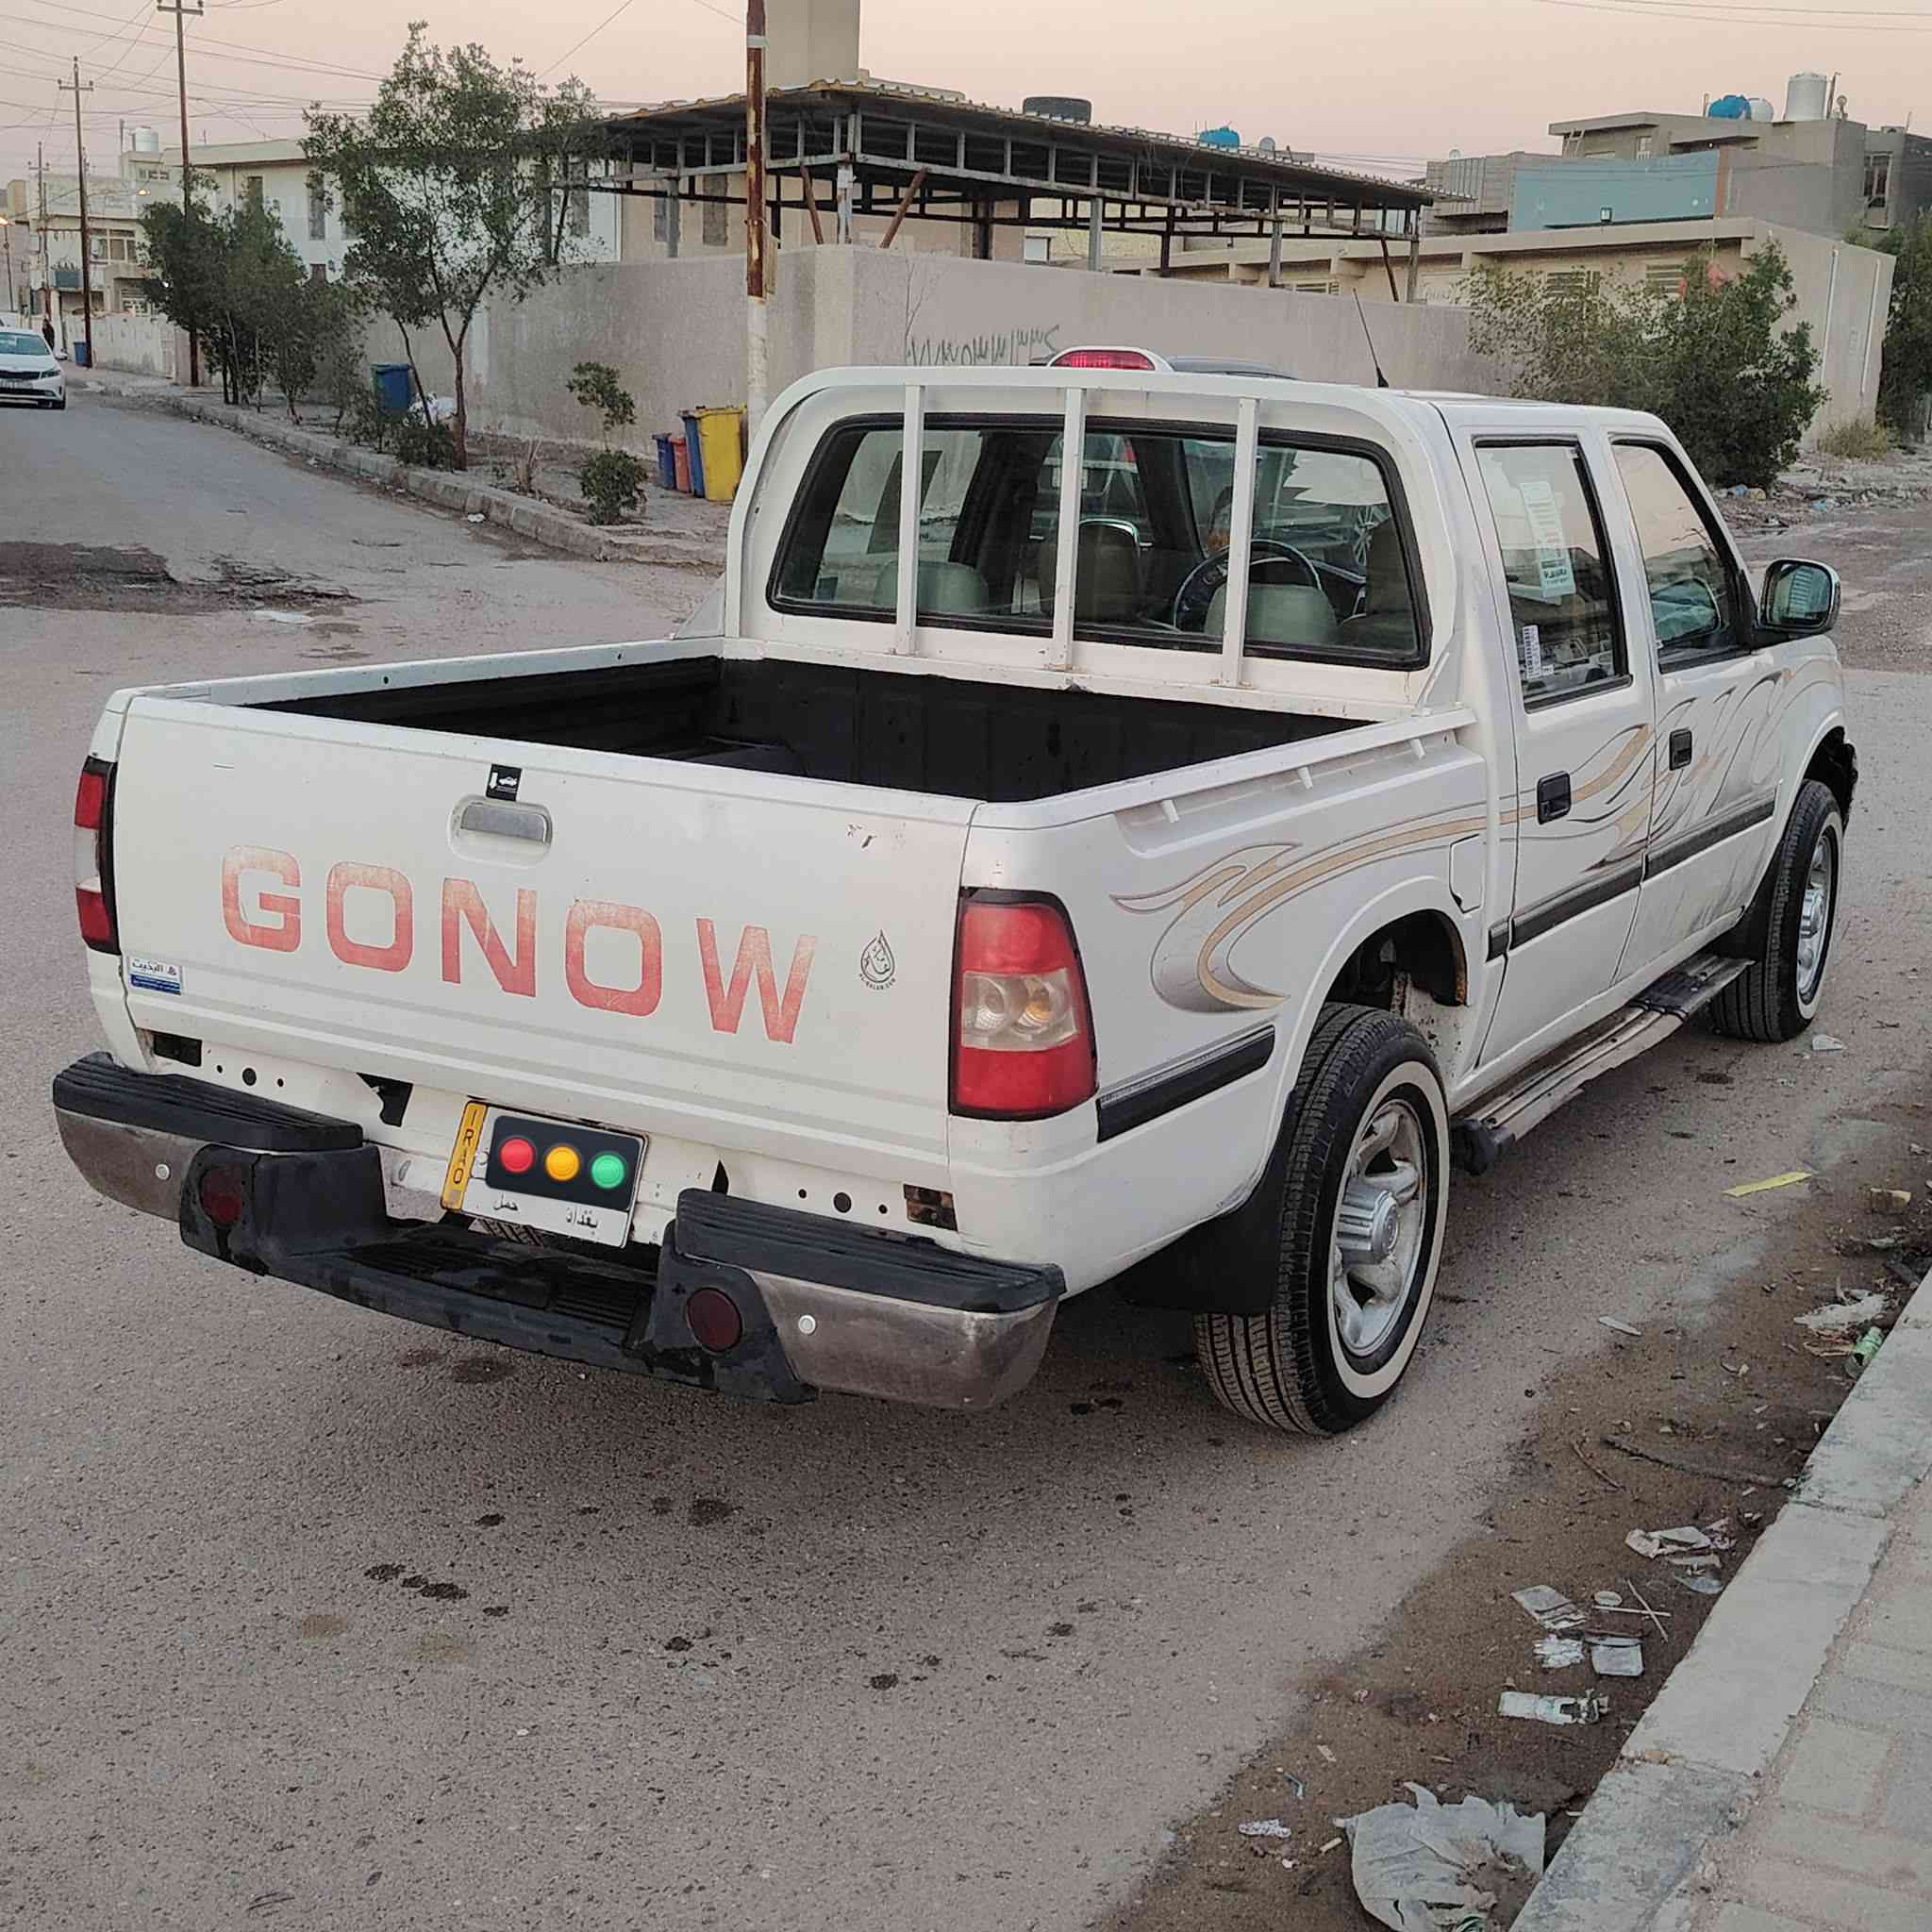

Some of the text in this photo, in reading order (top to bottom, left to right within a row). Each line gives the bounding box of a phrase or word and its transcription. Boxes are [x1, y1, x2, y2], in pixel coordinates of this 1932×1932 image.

[222, 845, 816, 1044] GONOW
[492, 1192, 599, 1236] بغداد حمل
